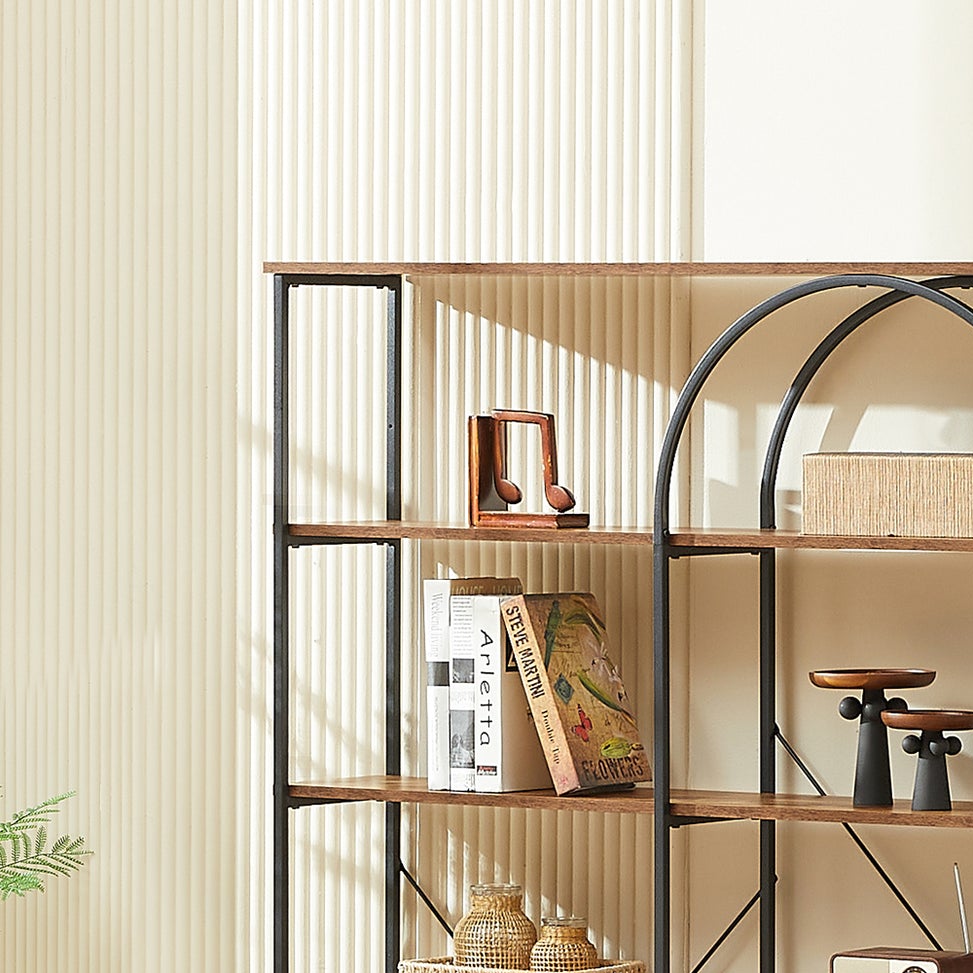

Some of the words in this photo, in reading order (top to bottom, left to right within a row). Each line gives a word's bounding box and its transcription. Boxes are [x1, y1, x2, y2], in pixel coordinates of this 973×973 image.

[431, 592, 443, 631] Weekend
[480, 629, 494, 746] Arletta
[506, 605, 529, 647] STEVE
[520, 647, 545, 699] MARTINI
[541, 709, 555, 744] Double
[582, 756, 644, 781] FLOWERS
